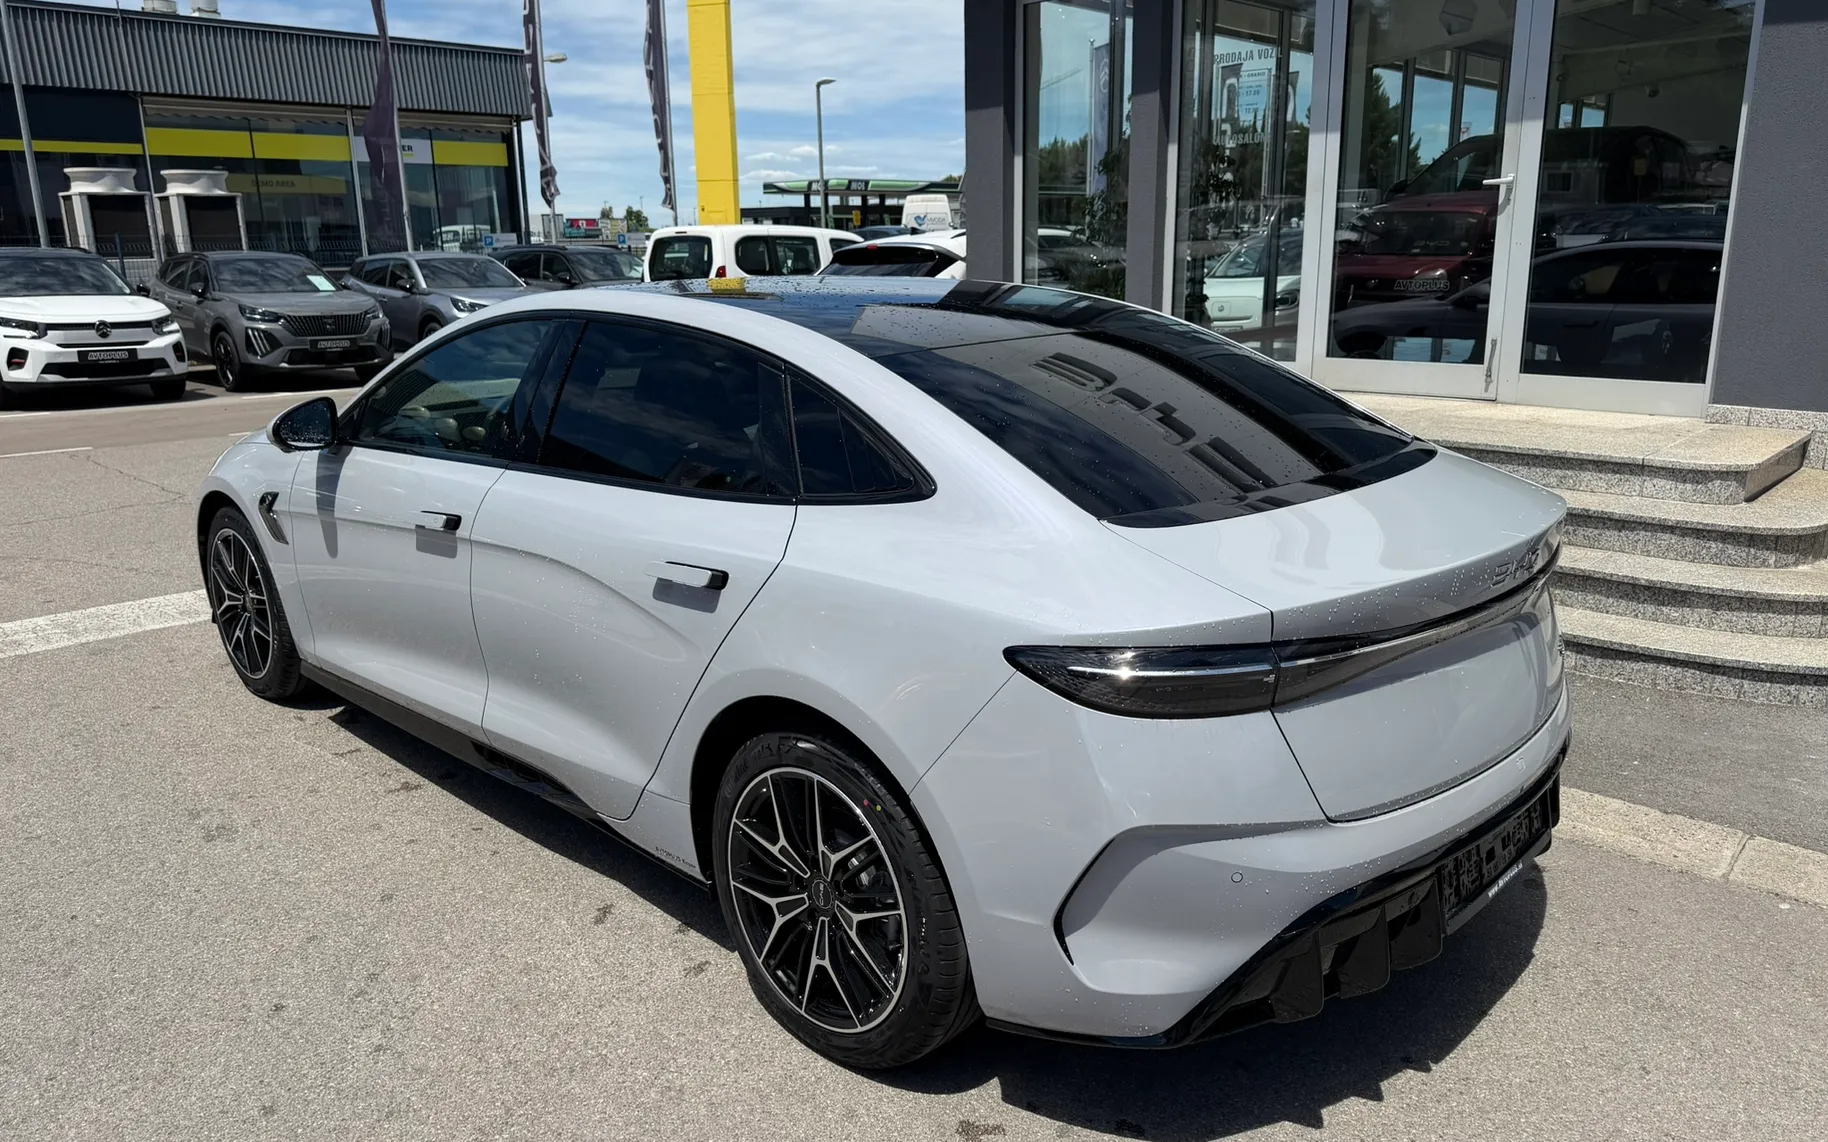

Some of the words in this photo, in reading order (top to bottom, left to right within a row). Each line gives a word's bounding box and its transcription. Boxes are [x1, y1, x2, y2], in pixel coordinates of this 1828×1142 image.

[1214, 50, 1254, 65] PRODAJA
[1257, 47, 1283, 60] VOZL
[851, 182, 866, 191] MOL
[1394, 280, 1450, 291] AVTOPLUS
[88, 350, 129, 360] AVTOPLUS
